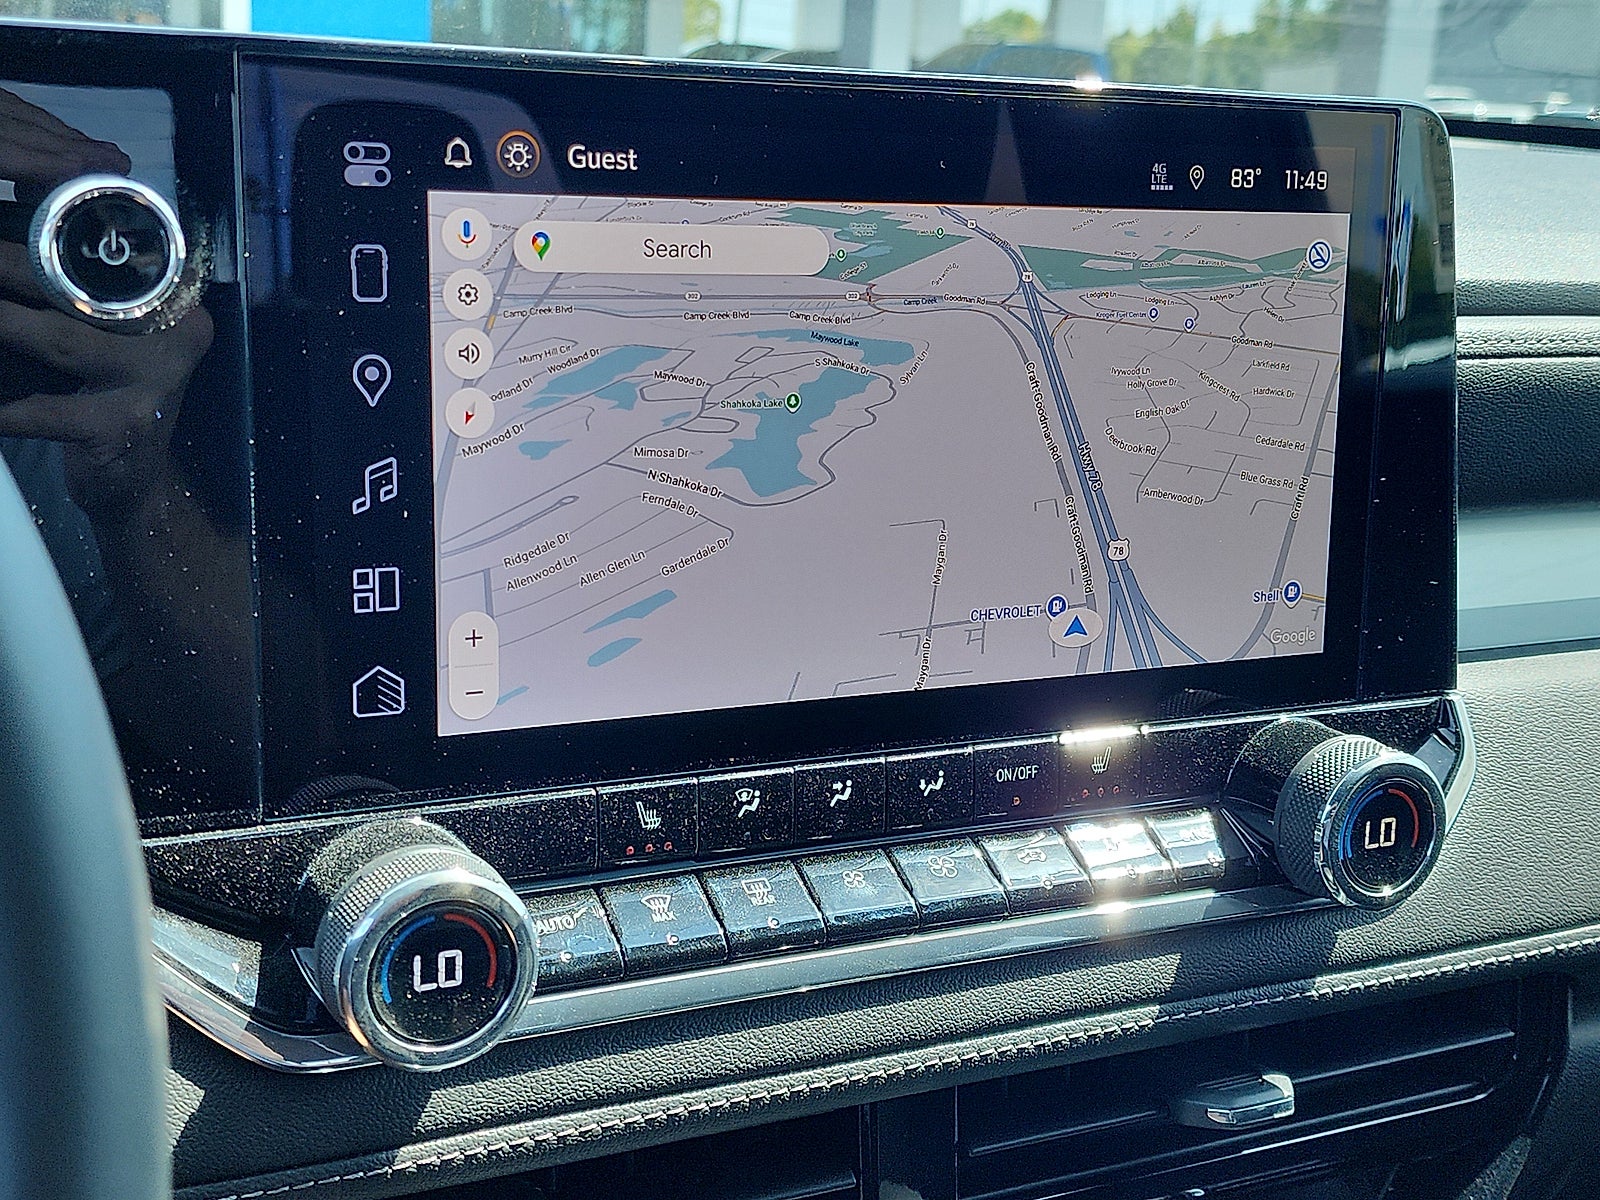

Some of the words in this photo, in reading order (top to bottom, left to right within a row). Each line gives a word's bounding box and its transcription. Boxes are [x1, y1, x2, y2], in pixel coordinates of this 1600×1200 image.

[567, 144, 639, 171] Guest
[1152, 163, 1167, 174] 4G
[1151, 174, 1168, 184] LTE
[1231, 167, 1262, 189] 83°
[1285, 169, 1328, 191] 11:49
[643, 238, 712, 258] Search
[922, 296, 938, 304] Creek
[944, 294, 975, 303] Goodman
[976, 297, 986, 305] Rd
[1145, 297, 1167, 305] Lodging
[503, 309, 527, 319] Camp
[529, 307, 552, 316] Creek
[555, 305, 573, 315] Blvd
[683, 312, 706, 321] Camp
[708, 311, 731, 319] Creek
[732, 310, 750, 319] Blvd
[789, 311, 810, 321] Camp
[812, 314, 834, 324] Creek
[835, 316, 851, 324] Blvd
[810, 331, 842, 345] Maywood
[843, 338, 860, 347] Lake
[1231, 335, 1263, 347] Goodman
[1264, 340, 1273, 348] Rd
[518, 353, 542, 365] Murry
[544, 348, 559, 358] Hill
[560, 345, 571, 354] Cir
[547, 353, 589, 374] Woodland
[590, 348, 600, 358] Dr
[814, 358, 821, 366] S
[822, 358, 859, 373] Shahkoka
[860, 365, 870, 375] Dr
[900, 360, 921, 385] Sylvan
[918, 351, 928, 364] Ln
[1111, 367, 1140, 376] Ivywood
[1252, 360, 1279, 371] Larkfield
[1281, 363, 1290, 371] Rd
[654, 370, 695, 385] Maywood
[696, 377, 706, 387] Dr
[1127, 381, 1146, 390] Holly
[1146, 379, 1167, 387] Grove
[1168, 378, 1177, 386] Dr
[1198, 370, 1230, 396] Kingcrest
[1229, 392, 1240, 402] Rd
[491, 382, 522, 402] odland
[521, 377, 533, 389] Dr
[1253, 387, 1285, 397] Hardwick
[720, 399, 762, 408] Shahkoka
[763, 399, 783, 408] Lake
[1026, 361, 1054, 446] Craft-Goodman
[1049, 445, 1061, 461] Rd
[1135, 408, 1163, 419] English
[1165, 406, 1180, 415] Oak
[1181, 400, 1190, 410] Dr
[461, 428, 512, 458] Maywood
[512, 422, 525, 434] Dr
[1105, 427, 1144, 454] Deerbrook
[1145, 446, 1157, 456] Rd
[1255, 434, 1293, 450] Cedardale
[1294, 442, 1305, 452] Rd
[633, 447, 674, 458] Mimosa
[677, 447, 689, 458] Dr
[1078, 441, 1096, 473] Hwy
[1088, 471, 1104, 493] 78
[647, 469, 658, 480] N
[658, 472, 709, 494] Shahkoka
[710, 486, 723, 499] Dr
[1240, 471, 1258, 483] Blue
[1259, 475, 1281, 487] Grass
[1282, 479, 1294, 489] Rd
[1297, 477, 1310, 493] Rd
[642, 492, 686, 512] Ferndale
[686, 505, 699, 518] Dr
[1143, 488, 1193, 504] Amberwood
[1194, 496, 1204, 506] Dr
[1290, 494, 1305, 520] Craft
[938, 529, 948, 542] Dr
[503, 539, 556, 568] Ridgedale
[557, 532, 571, 545] Dr
[1064, 497, 1092, 578] Craft-Goodman
[1084, 578, 1094, 594] Rd
[1112, 546, 1124, 556] 78
[661, 544, 717, 577] Gardendale
[717, 537, 730, 550] Dr
[932, 542, 946, 585] Maygan
[506, 560, 562, 591] Allenwood
[564, 554, 578, 568] Ln
[579, 569, 606, 587] Allen
[607, 557, 631, 574] Glen
[631, 550, 646, 564] Ln
[1253, 589, 1279, 603] Shell
[970, 604, 1042, 622] CHEVROLET
[1270, 627, 1316, 645] Google
[914, 650, 931, 691] Maygan
[923, 637, 932, 650] Dr
[996, 764, 1040, 783] ON/OFF
[1364, 817, 1397, 850] LO
[536, 914, 575, 935] AUTO
[651, 910, 677, 923] MAX
[413, 948, 463, 993] LO
